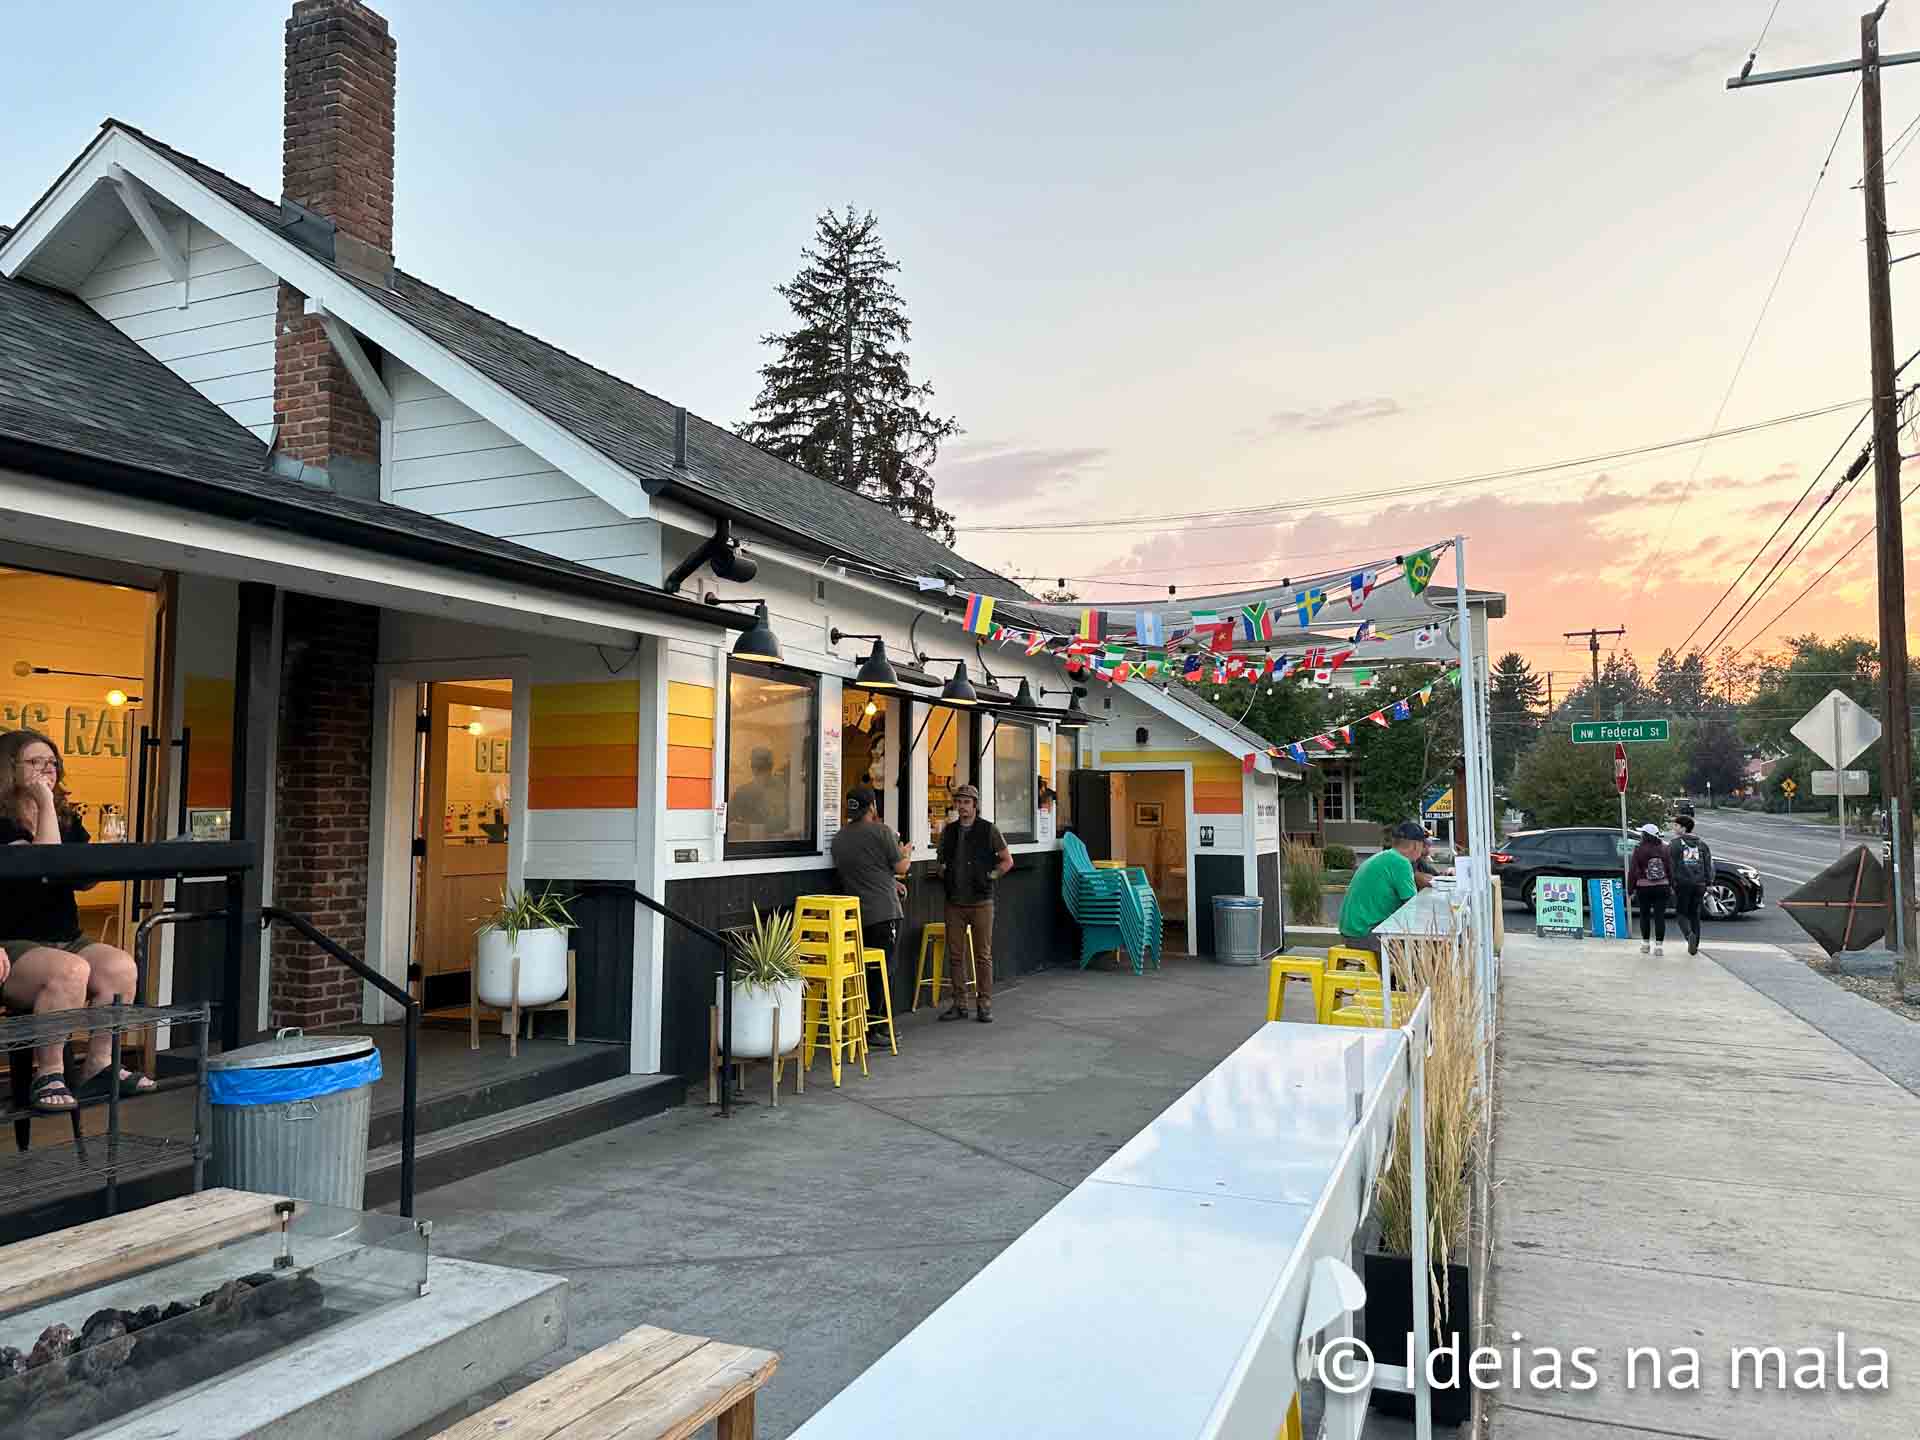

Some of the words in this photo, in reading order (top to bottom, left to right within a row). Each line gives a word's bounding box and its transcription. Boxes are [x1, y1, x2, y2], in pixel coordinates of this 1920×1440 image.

[64, 704, 127, 757] RA
[1580, 729, 1594, 739] NW
[1600, 726, 1643, 738] Federal
[1650, 727, 1659, 736] St
